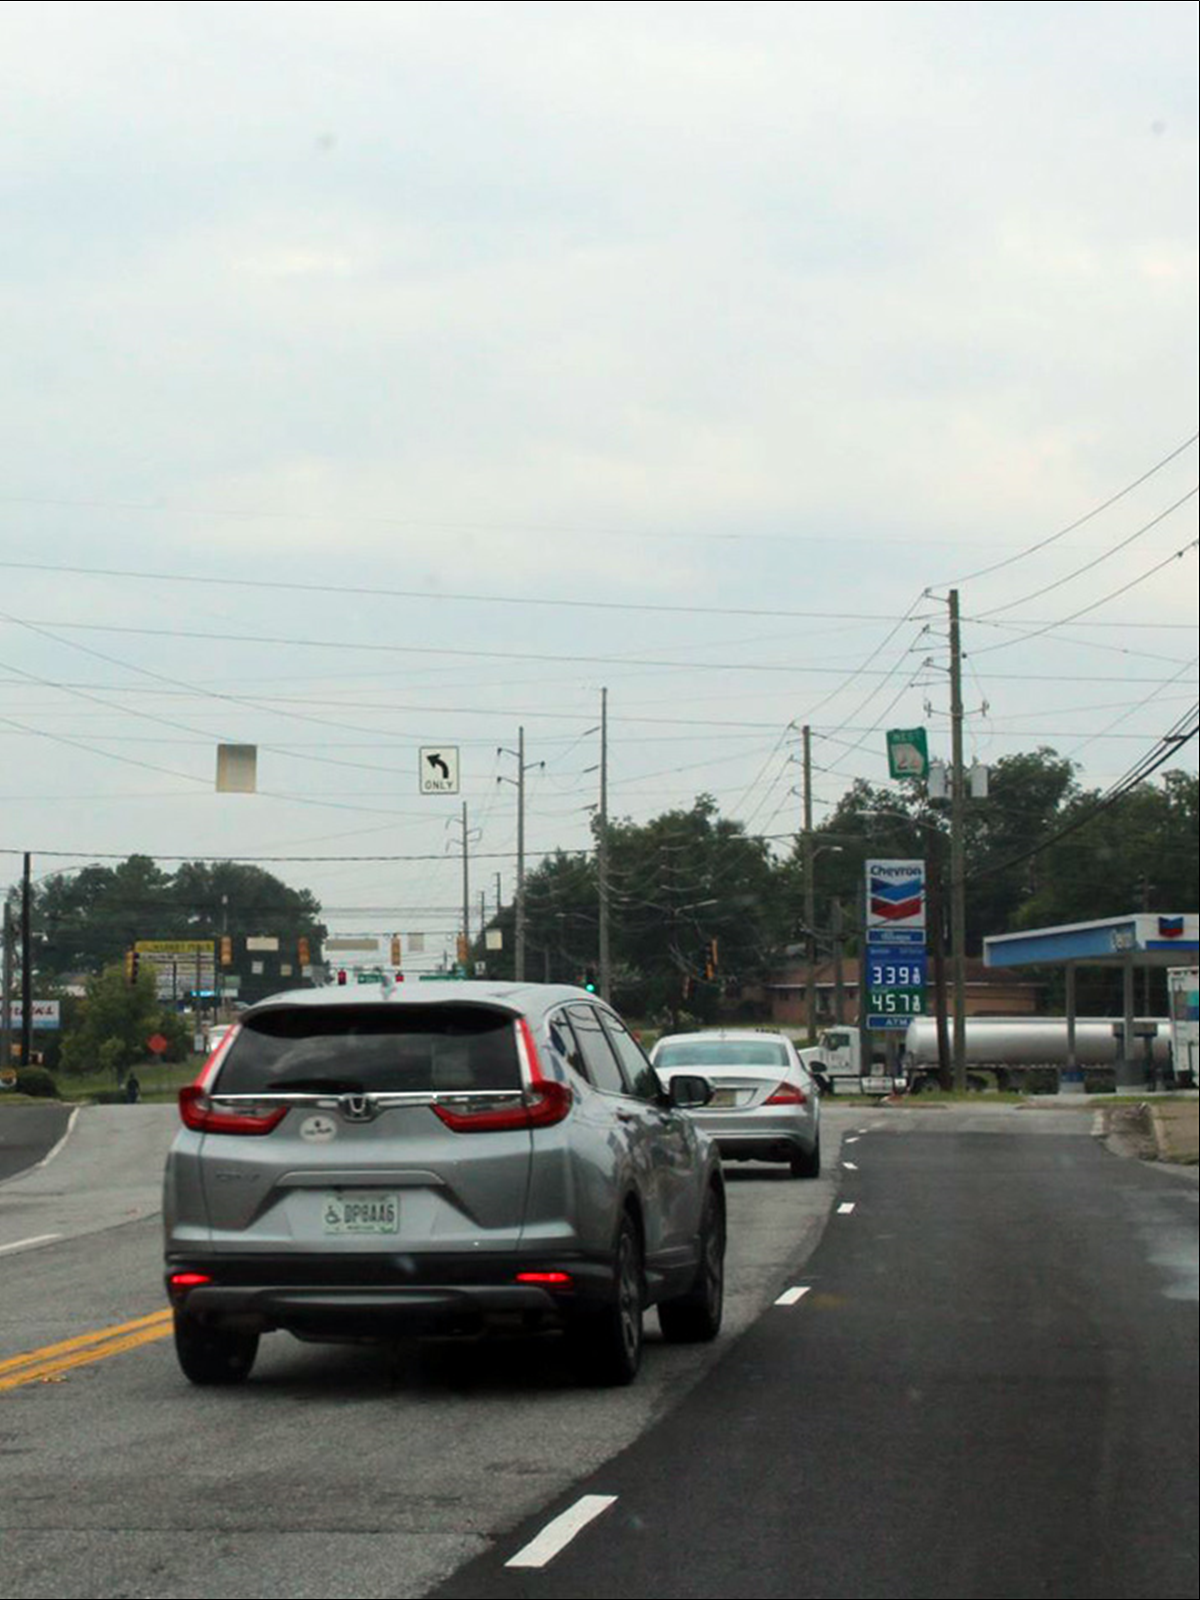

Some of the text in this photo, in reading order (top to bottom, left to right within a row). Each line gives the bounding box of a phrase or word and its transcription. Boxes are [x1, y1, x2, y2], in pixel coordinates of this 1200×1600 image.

[424, 780, 454, 790] ONLY
[870, 864, 922, 877] Chevron
[885, 1018, 909, 1026] ATM
